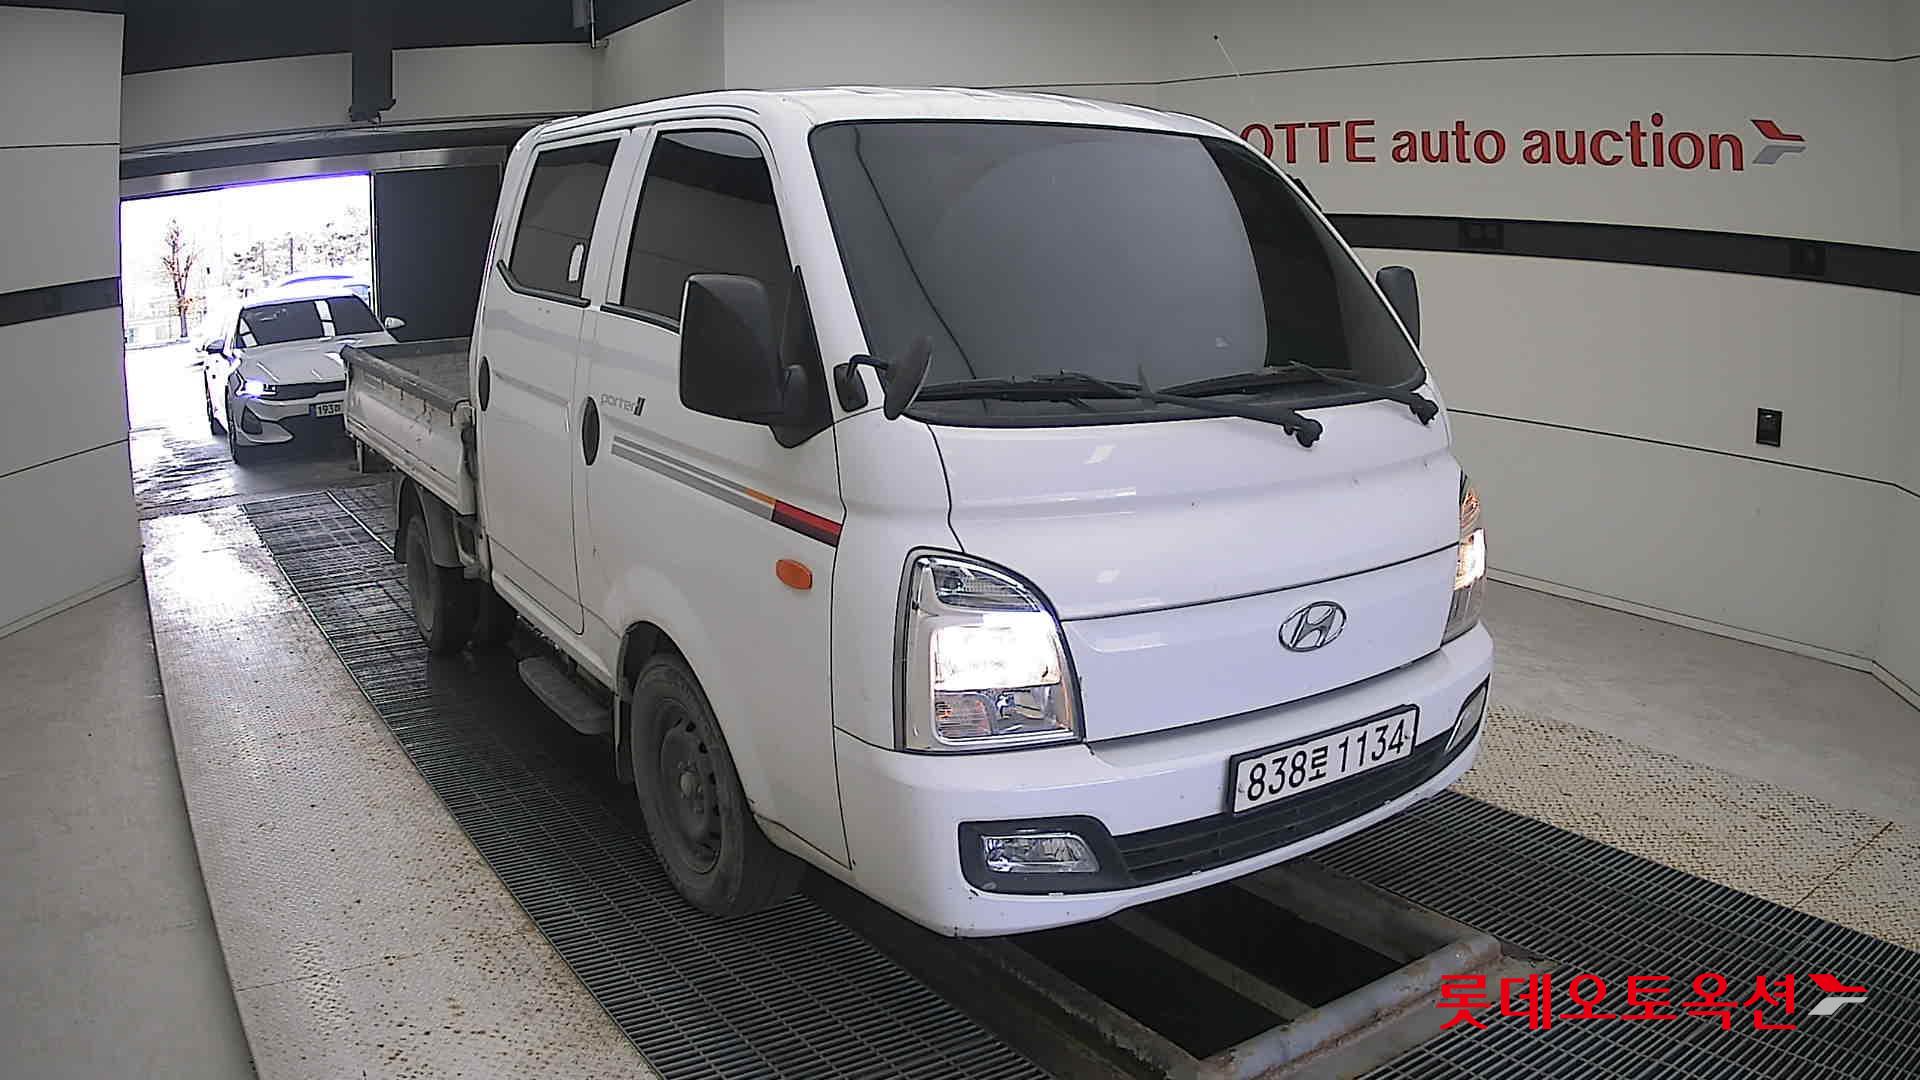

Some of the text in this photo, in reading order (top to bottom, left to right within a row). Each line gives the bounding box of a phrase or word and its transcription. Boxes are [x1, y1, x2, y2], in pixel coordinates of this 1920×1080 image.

[1239, 112, 1744, 171] OTTE auto auction
[1247, 719, 1407, 801] 838로 1134
